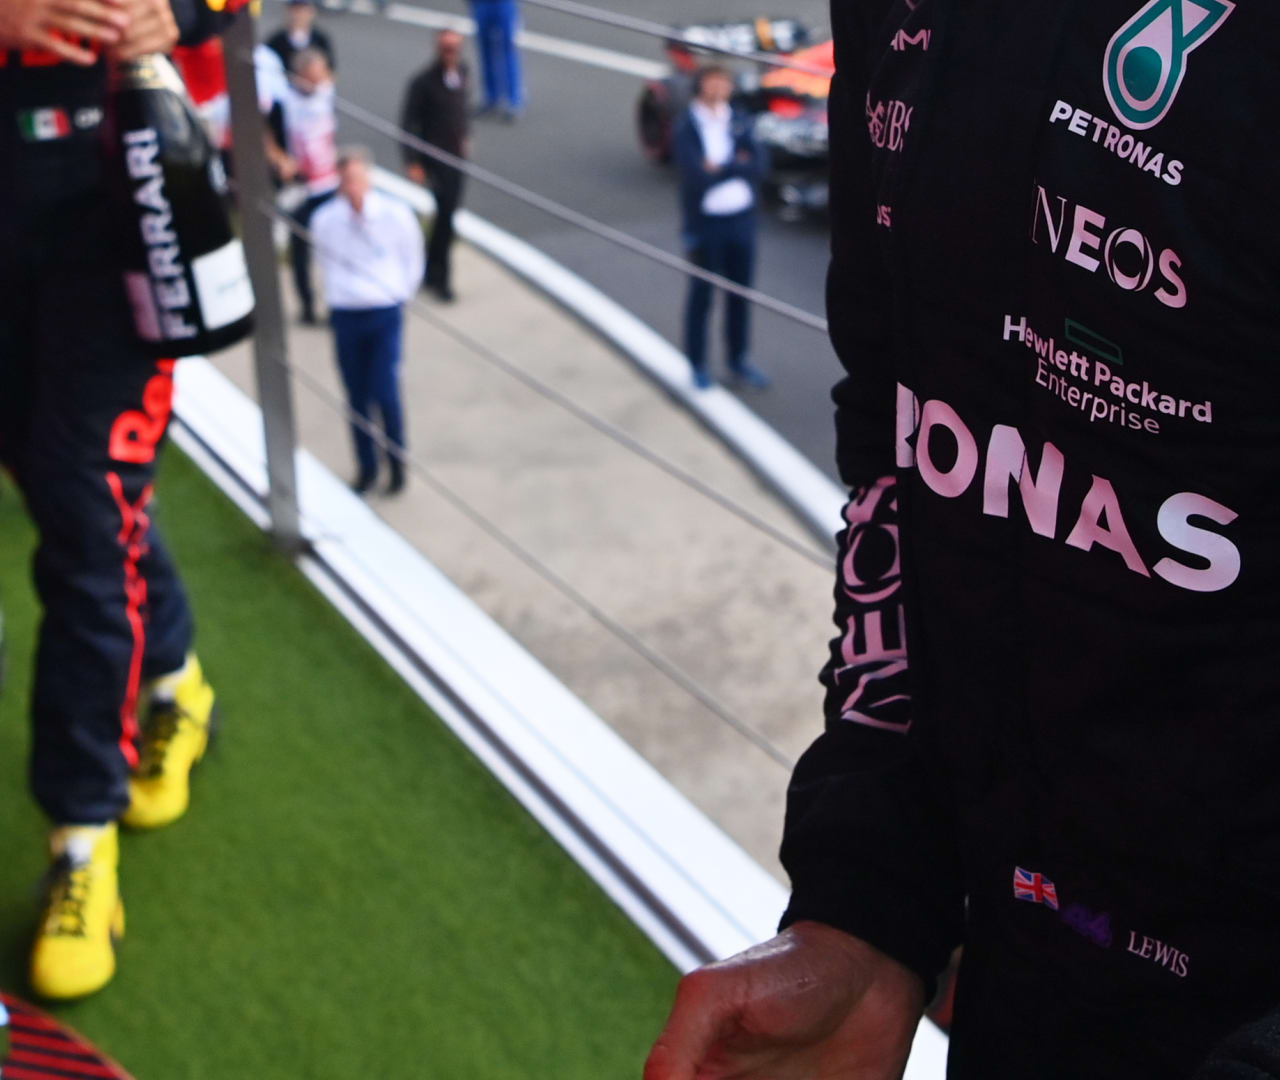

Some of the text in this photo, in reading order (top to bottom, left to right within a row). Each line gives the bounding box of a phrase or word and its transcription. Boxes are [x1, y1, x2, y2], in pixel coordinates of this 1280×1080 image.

[1049, 99, 1185, 186] PETRONAS
[123, 127, 199, 341] FERRARI
[1003, 315, 1214, 424] Hewlett Packard
[1035, 357, 1161, 434] Enterprise
[1127, 931, 1190, 978] LEWIS
